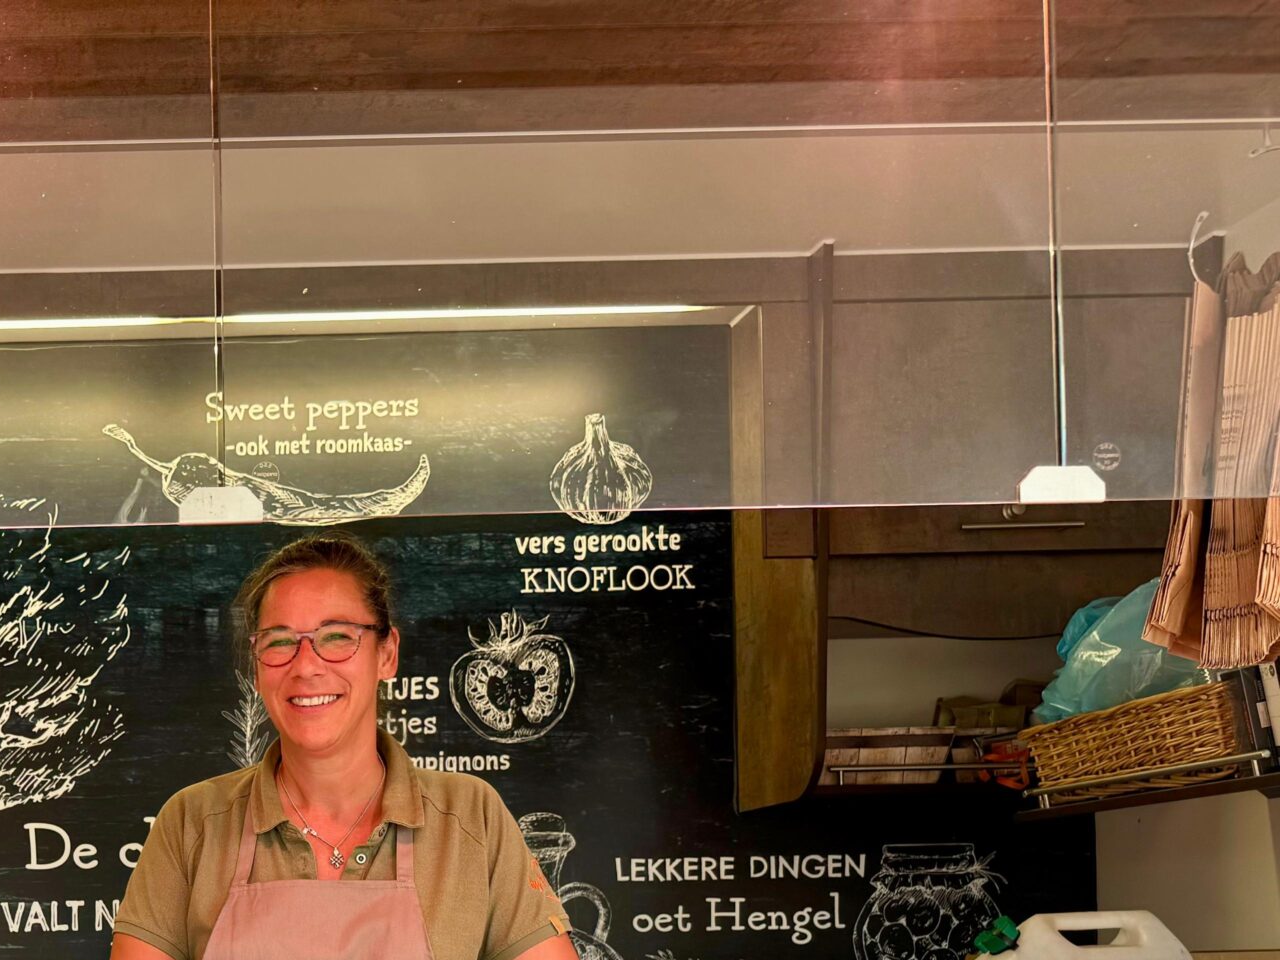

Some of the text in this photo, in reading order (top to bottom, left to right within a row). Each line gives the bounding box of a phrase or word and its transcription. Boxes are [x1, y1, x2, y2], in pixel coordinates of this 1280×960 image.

[205, 391, 420, 431] Sweet peppers
[225, 430, 413, 456] -ook met roomkaas-
[515, 526, 682, 560] vers gerookte
[520, 565, 695, 594] KNOFLOOK
[23, 822, 99, 870] De
[615, 853, 867, 883] LEKKERE DINGEN
[0, 900, 86, 933] VALT
[633, 892, 847, 946] oet Hengel
